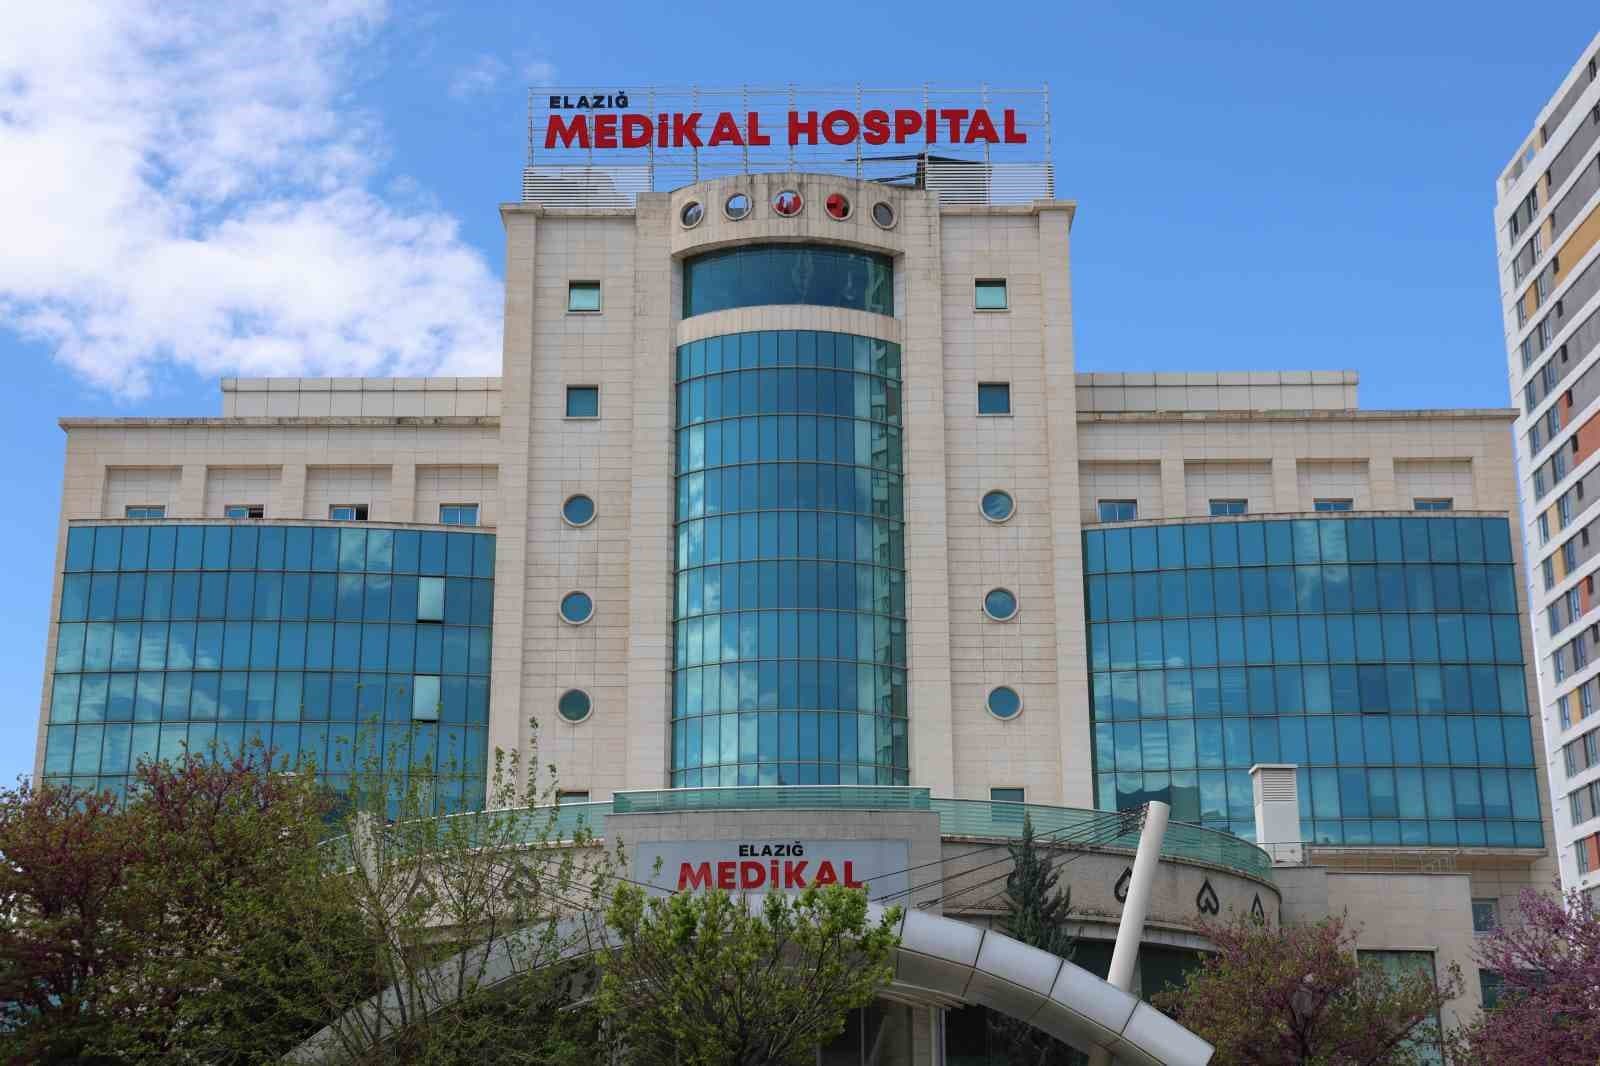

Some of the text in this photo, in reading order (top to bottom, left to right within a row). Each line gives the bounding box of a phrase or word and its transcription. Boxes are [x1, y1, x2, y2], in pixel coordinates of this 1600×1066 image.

[549, 90, 628, 109] ELAZIĞ
[788, 108, 1026, 146] HOSPITAL
[738, 840, 804, 857] ELAZIĞ
